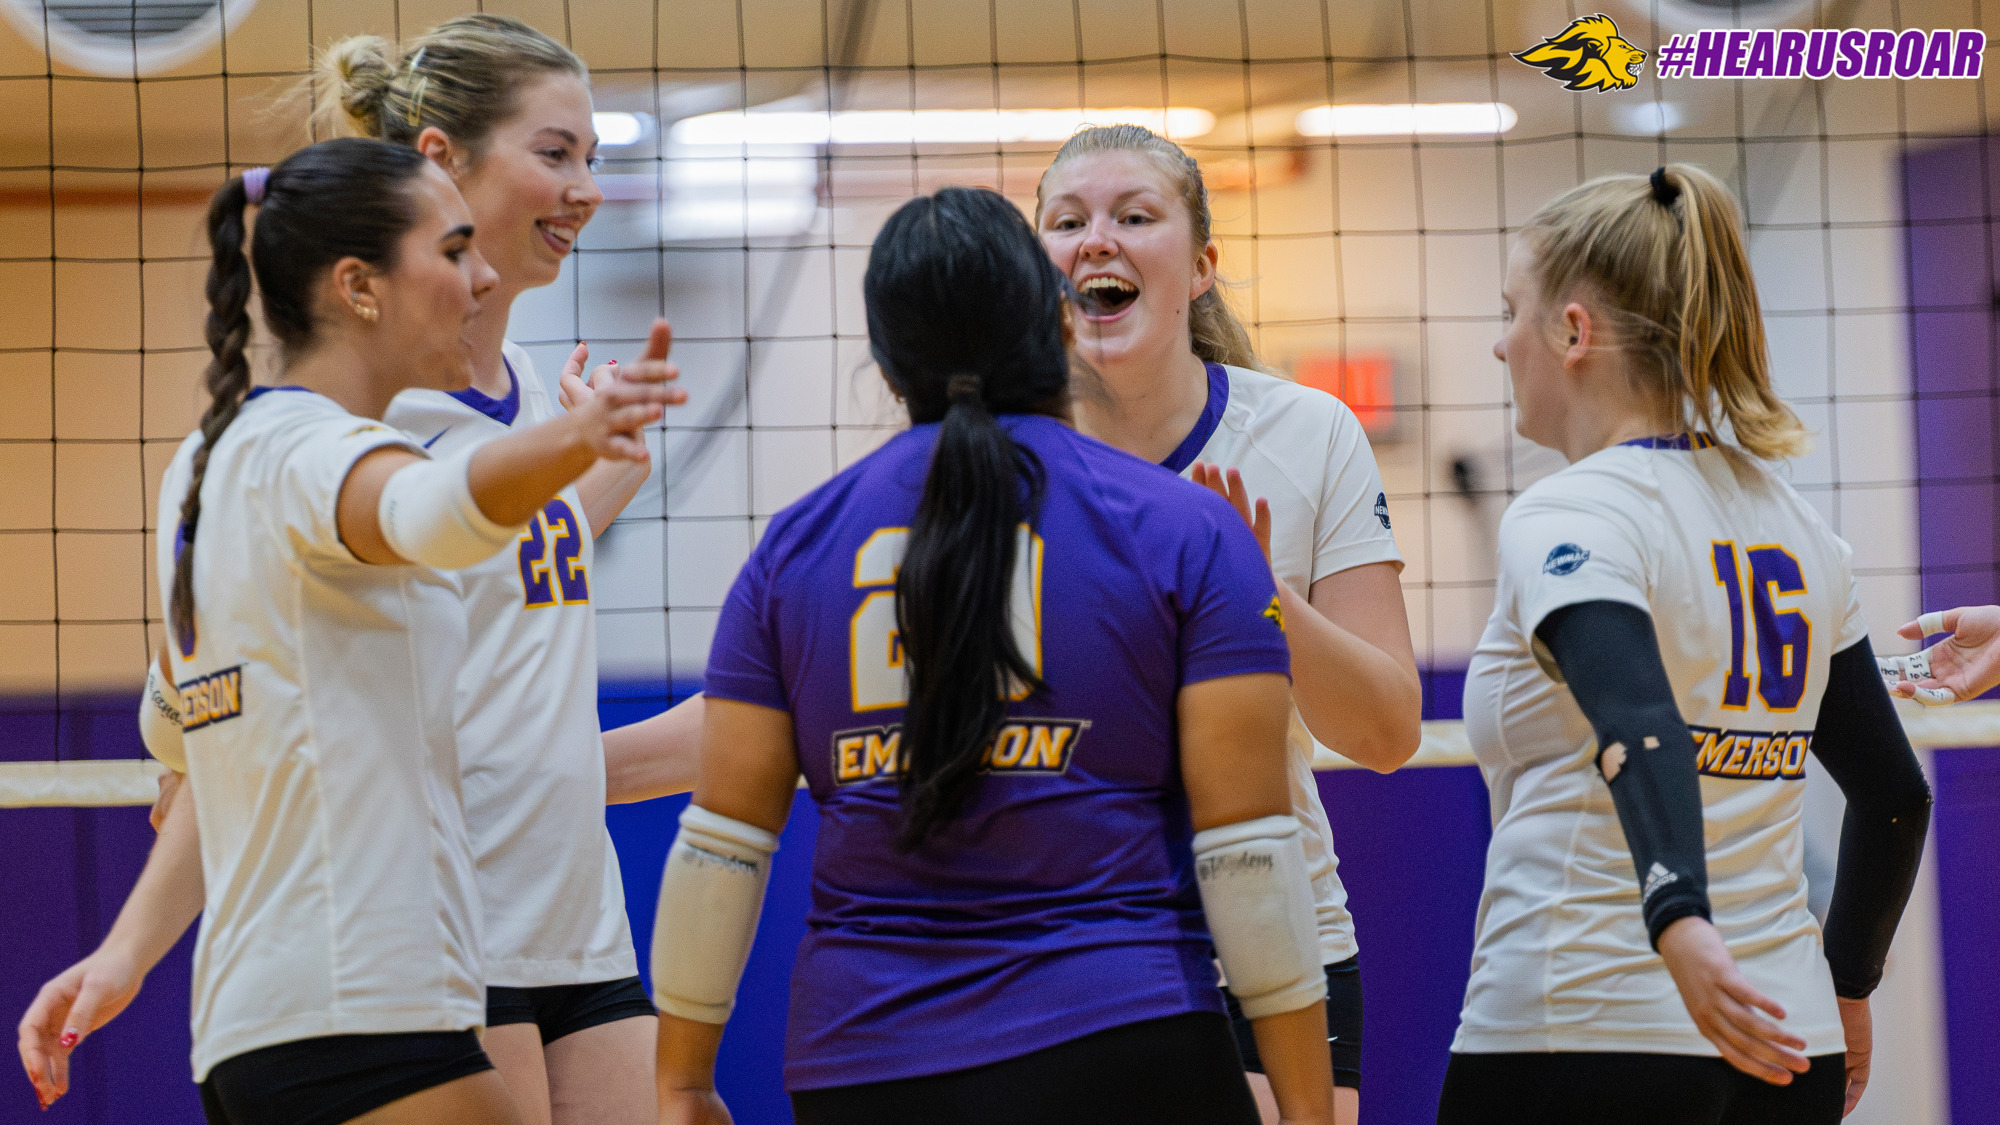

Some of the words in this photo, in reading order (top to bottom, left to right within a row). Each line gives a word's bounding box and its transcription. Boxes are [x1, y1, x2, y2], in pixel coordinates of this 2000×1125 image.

[517, 496, 589, 610] 22
[1543, 549, 1590, 574] NEWMAC
[1710, 539, 1812, 713] 16
[179, 670, 241, 728] ERSON
[837, 724, 1073, 779] EMON
[1691, 729, 1812, 776] MERSO
